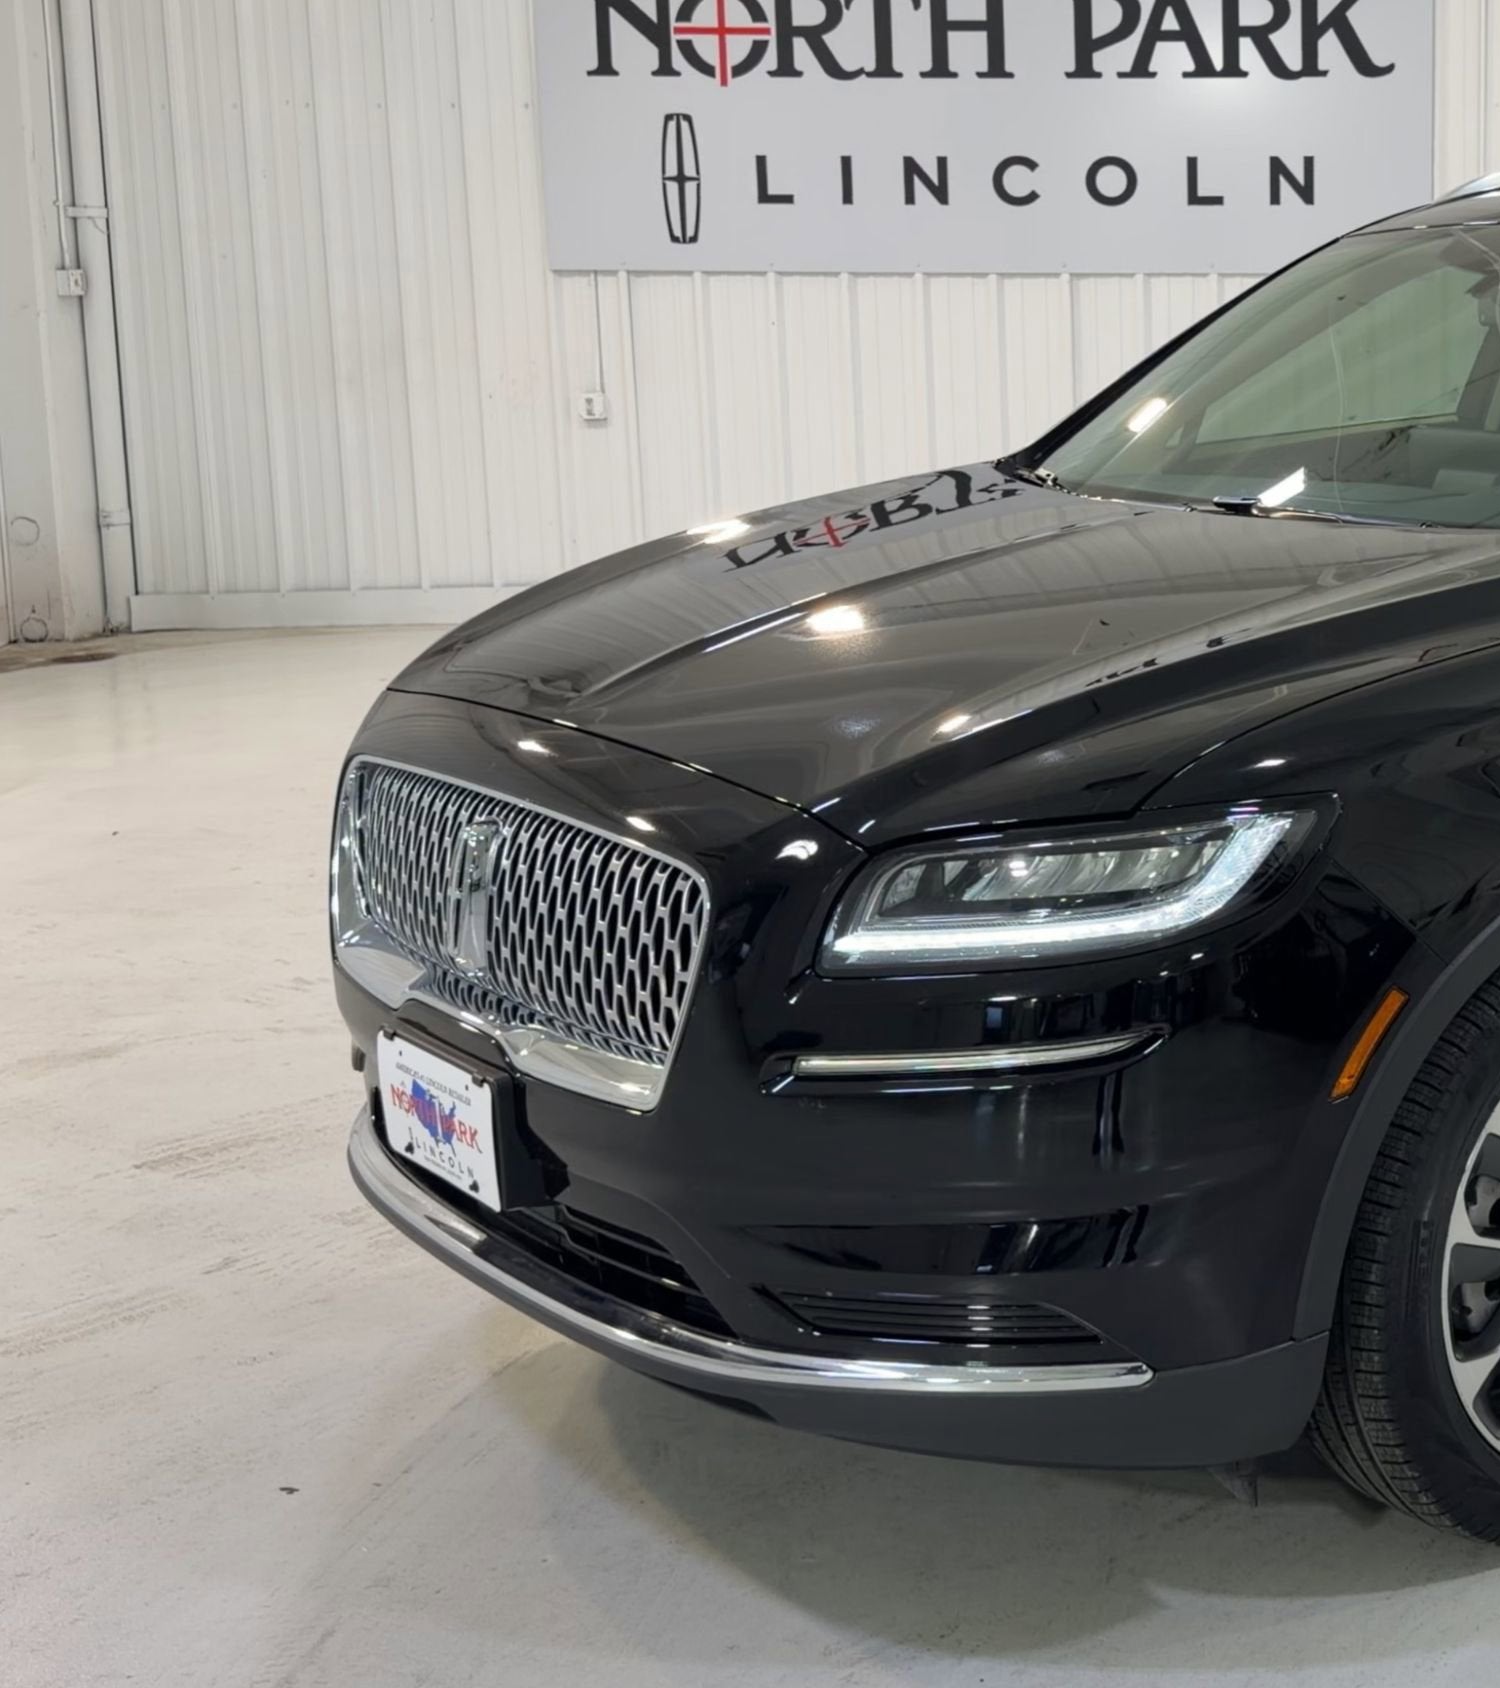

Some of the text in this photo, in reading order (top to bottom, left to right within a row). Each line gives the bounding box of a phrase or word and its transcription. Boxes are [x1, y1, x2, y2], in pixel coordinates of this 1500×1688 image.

[585, 0, 1395, 86] NORTH PARK
[755, 154, 1316, 207] LINCOLN
[415, 1136, 475, 1179] LINCOLN
